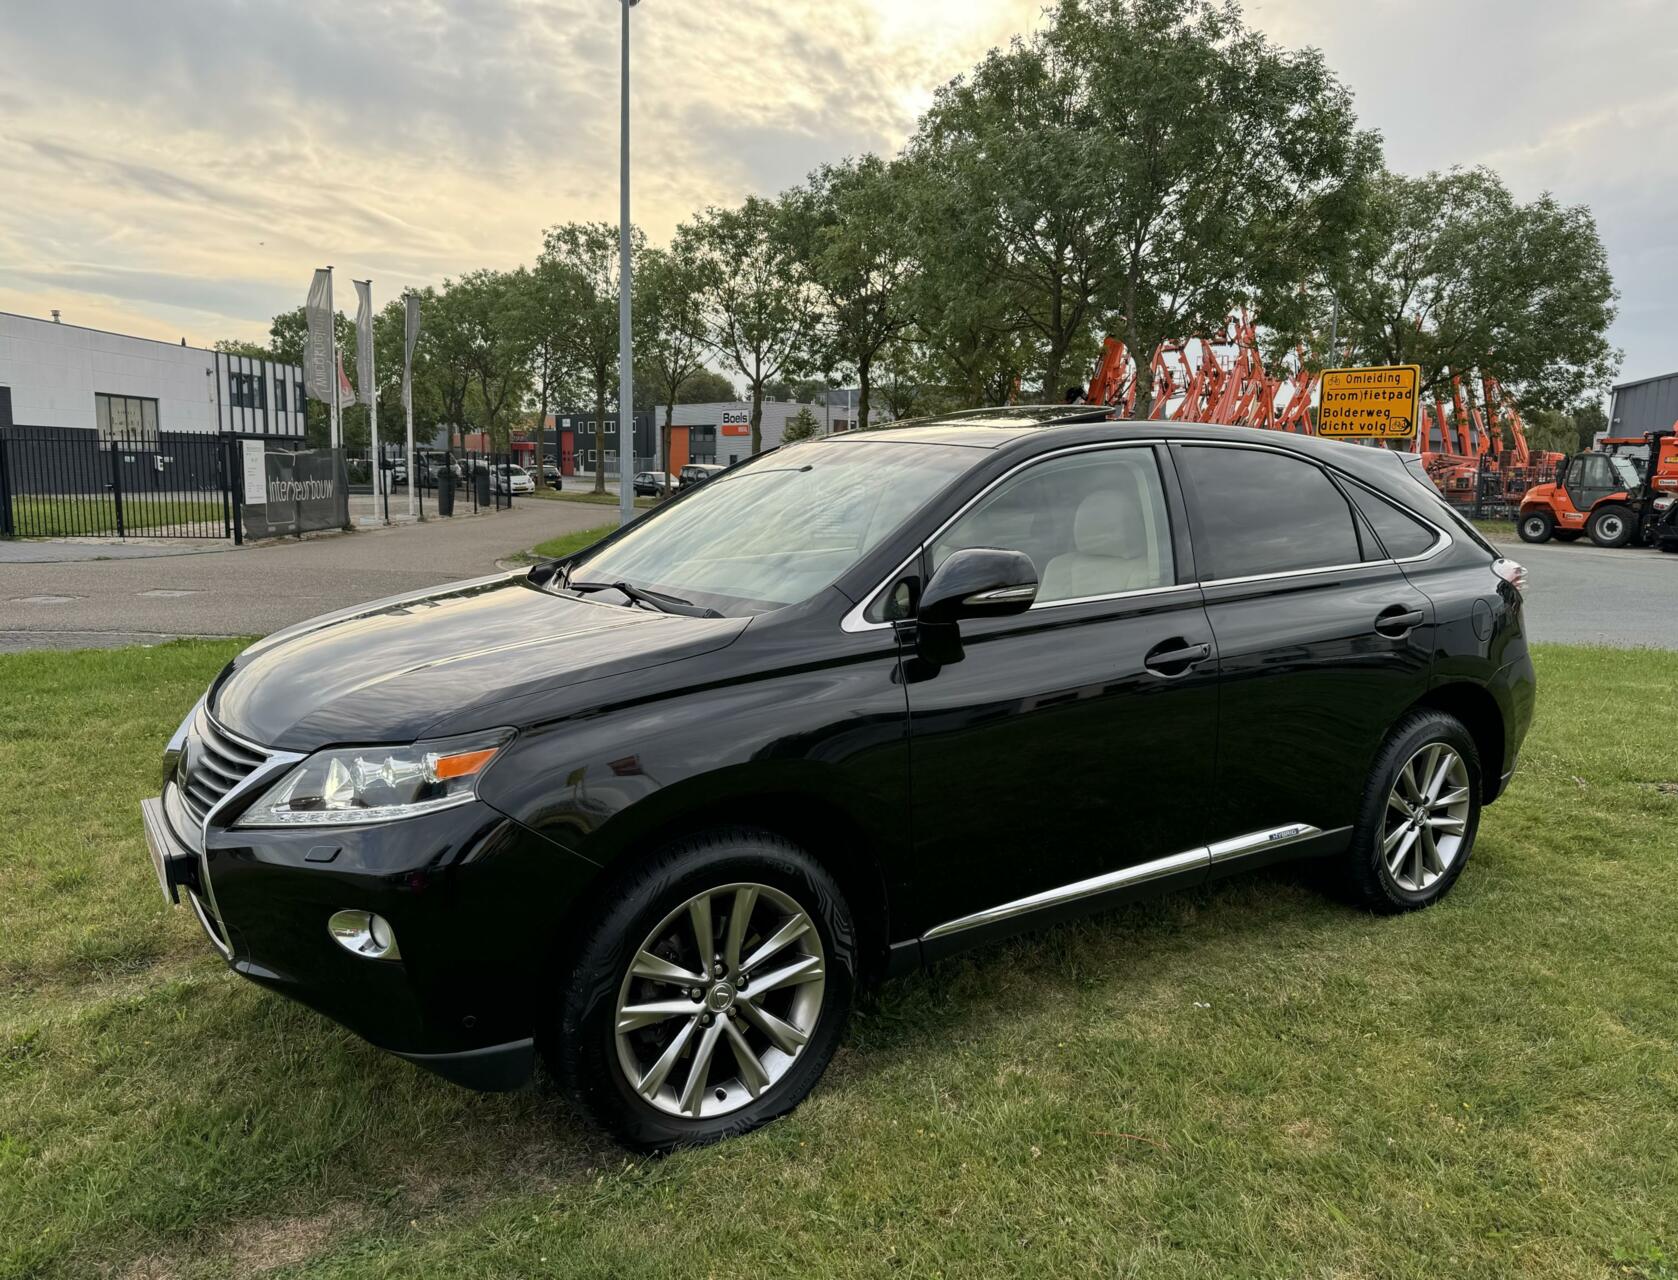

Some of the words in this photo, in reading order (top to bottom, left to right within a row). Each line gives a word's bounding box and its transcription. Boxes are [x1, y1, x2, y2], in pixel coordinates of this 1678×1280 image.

[1346, 374, 1401, 385] Omleiding
[1322, 389, 1412, 403] (brom)fietpad
[723, 411, 748, 423] Boels
[1323, 408, 1391, 420] Bolderweg
[1321, 421, 1354, 431] dicht
[1360, 421, 1386, 433] volg
